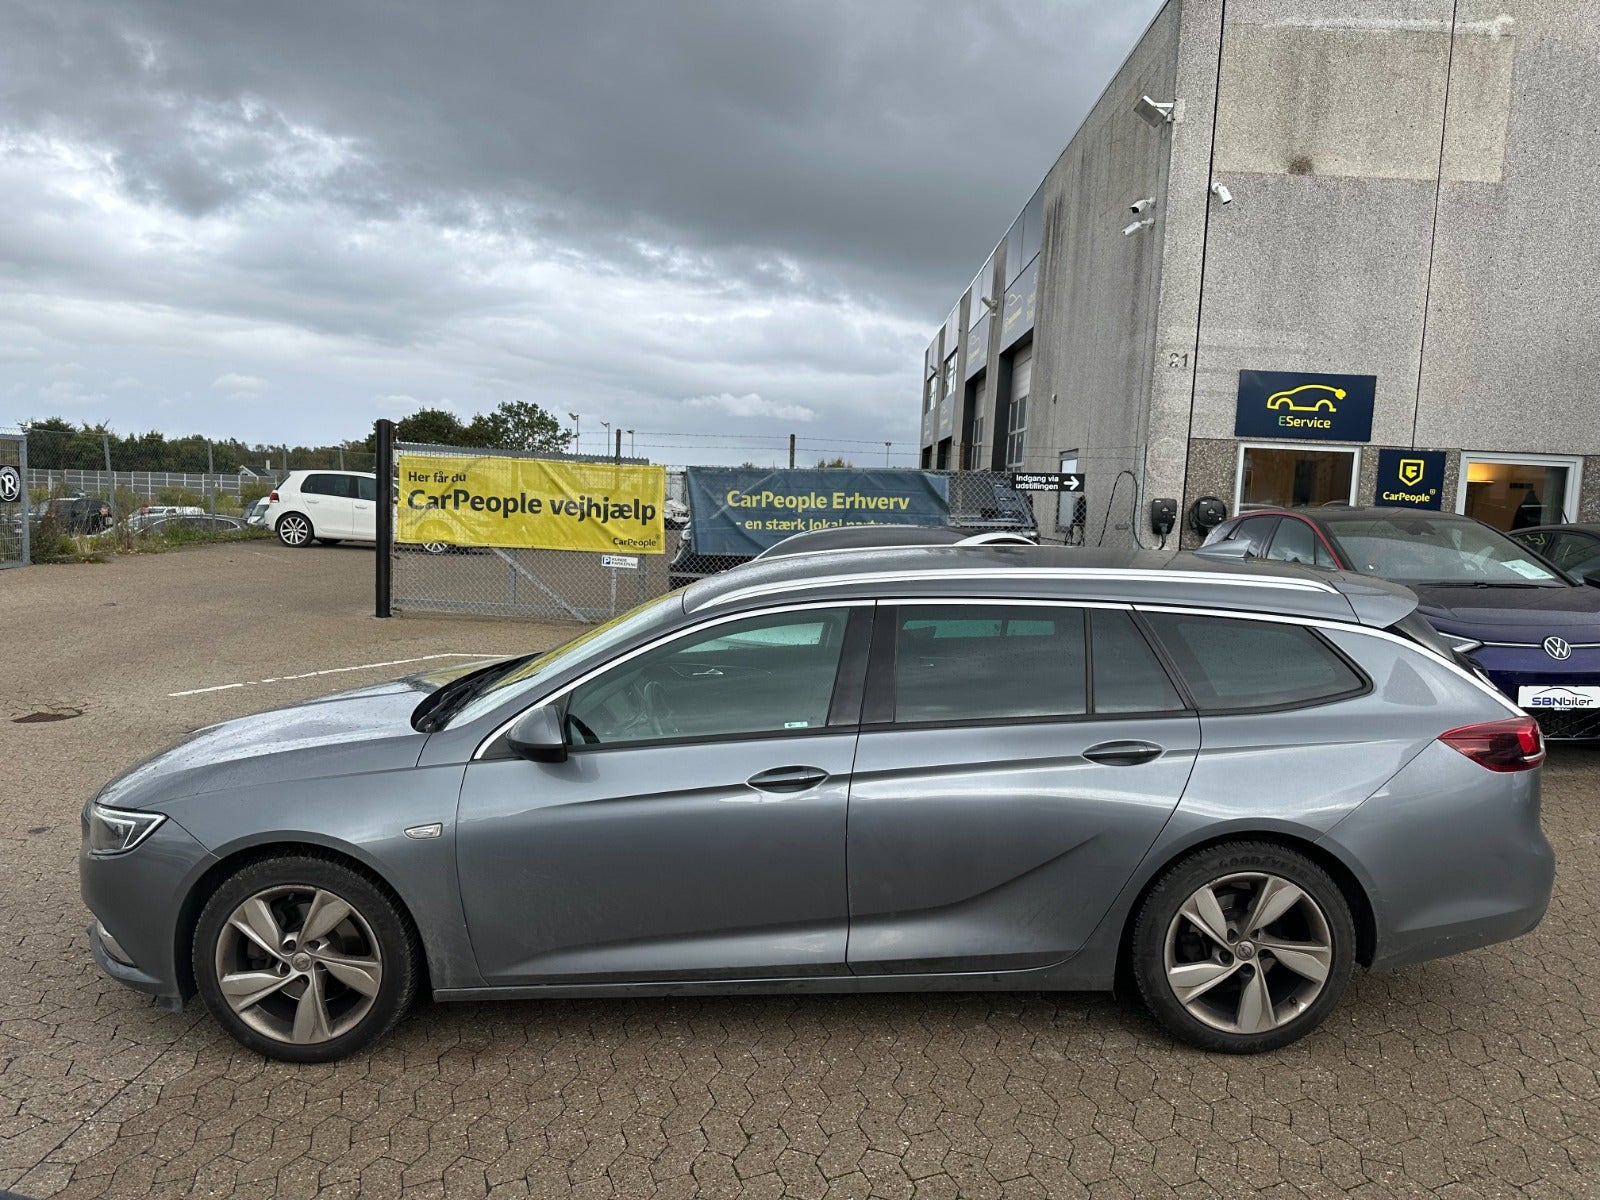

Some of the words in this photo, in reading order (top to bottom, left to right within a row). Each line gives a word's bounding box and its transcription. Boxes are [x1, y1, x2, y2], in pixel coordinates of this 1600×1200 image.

[1278, 415, 1331, 429] EService
[408, 471, 430, 482] Her
[433, 470, 449, 483] får
[451, 473, 467, 482] du
[1016, 474, 1046, 483] Indgang
[1015, 482, 1059, 491] udstillingen
[727, 490, 828, 513] CarPeople
[832, 492, 910, 510] Erhverv
[1382, 491, 1430, 504] CarPeople
[407, 489, 542, 518] CarPeople
[550, 495, 656, 526] vejhjælp
[745, 520, 762, 530] en
[765, 518, 806, 531] stærk
[612, 537, 657, 548] CarPeople
[1531, 696, 1594, 706] SBNbiler
